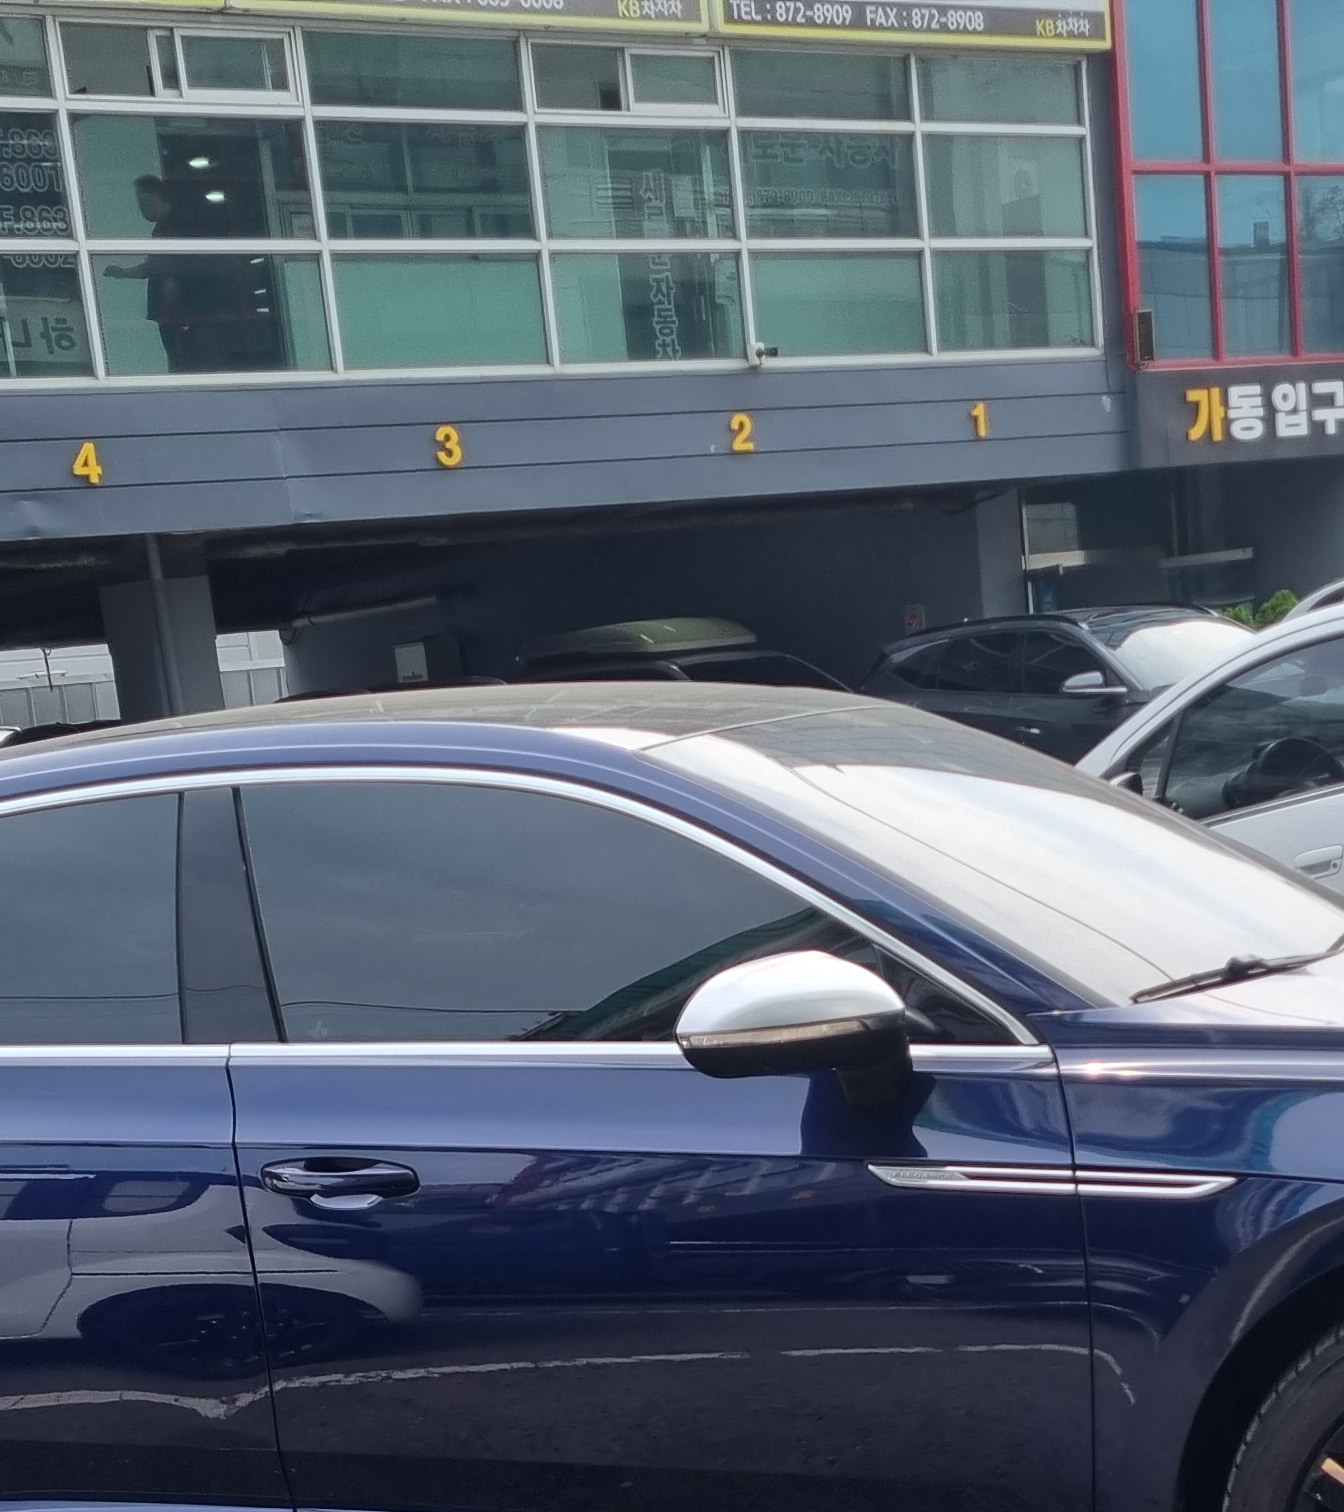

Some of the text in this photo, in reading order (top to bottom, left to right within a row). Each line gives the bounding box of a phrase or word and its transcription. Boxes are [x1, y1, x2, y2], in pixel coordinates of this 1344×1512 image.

[911, 9, 985, 31] 872-8908
[729, 413, 755, 452] 2
[969, 403, 990, 438] 1
[73, 442, 103, 484] 4
[435, 426, 463, 468] 3
